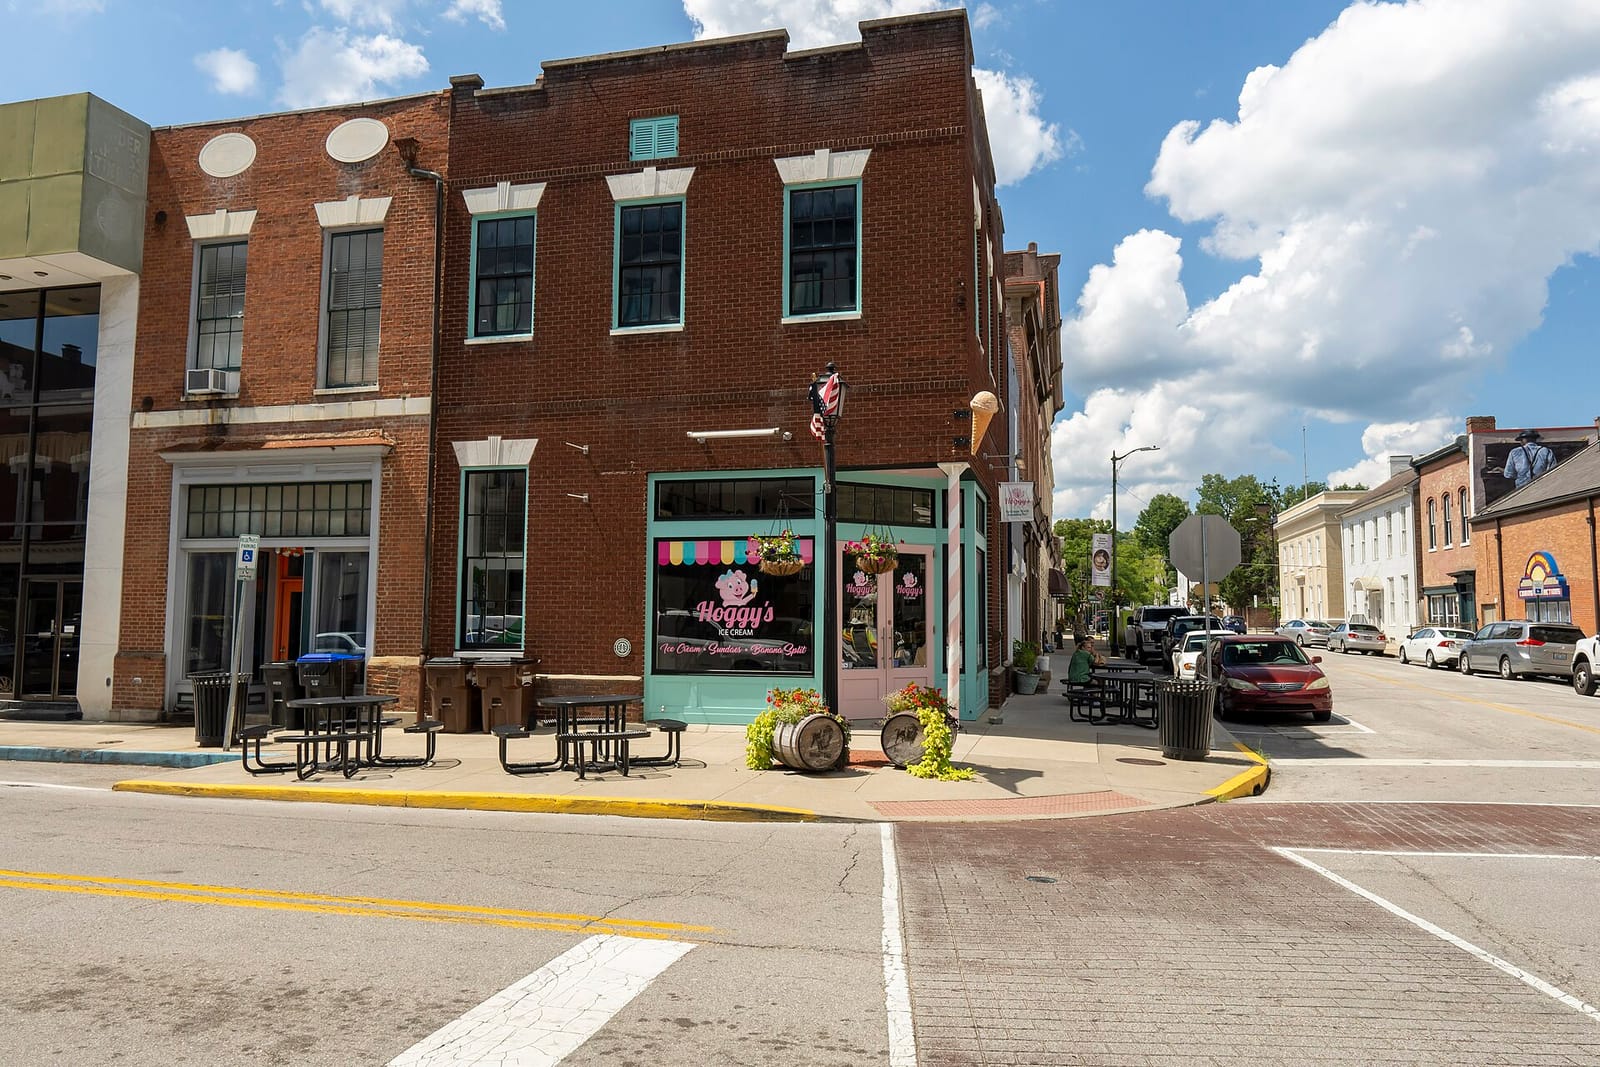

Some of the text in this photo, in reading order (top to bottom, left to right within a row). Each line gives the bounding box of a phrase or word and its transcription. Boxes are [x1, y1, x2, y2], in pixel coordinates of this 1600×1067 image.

[896, 584, 923, 597] Hoggy's
[696, 600, 774, 629] Hoggy's
[718, 628, 754, 637] ICE CREAM
[660, 642, 807, 657] Ice Cream Sundaes Banana Split
